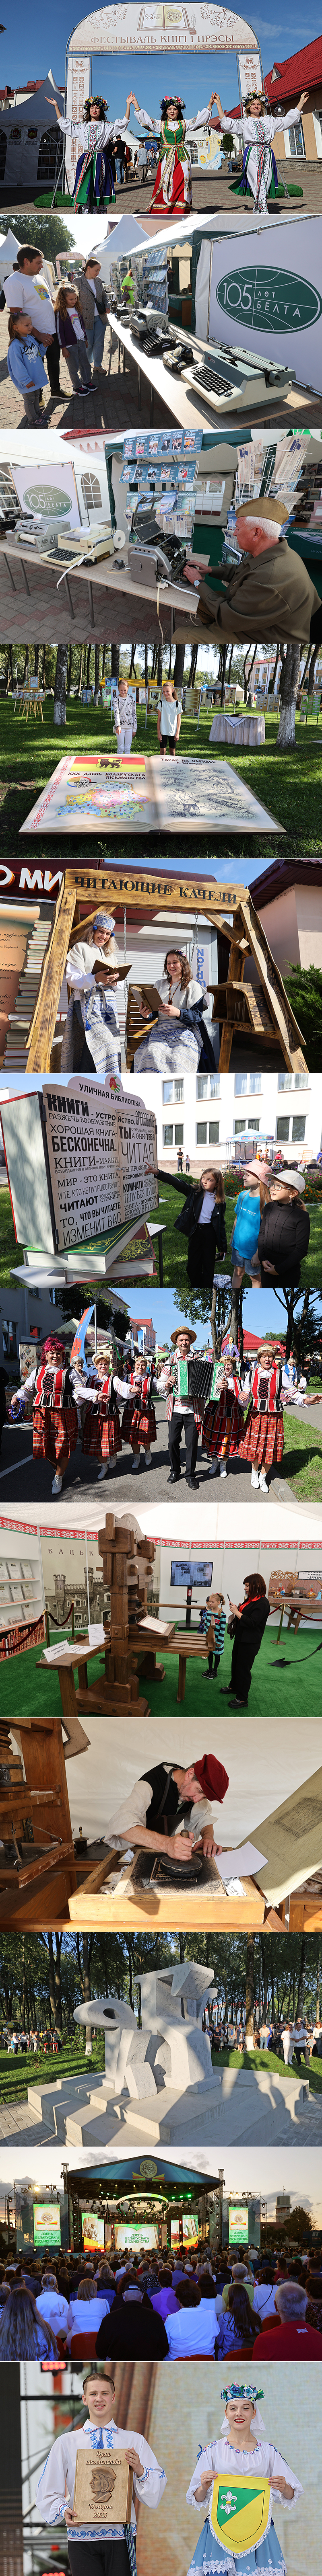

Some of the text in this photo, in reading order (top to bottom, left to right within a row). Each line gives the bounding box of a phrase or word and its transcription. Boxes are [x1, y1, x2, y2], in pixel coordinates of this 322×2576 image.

[90, 36, 157, 44] ФЕСТЫВАЛЬ
[197, 35, 234, 43] ПРЭСЫ
[223, 283, 252, 310] 105
[257, 301, 301, 318] БЕЛТА
[27, 494, 46, 509] 105
[74, 876, 237, 904] ЧИТАЮЩИЕ КАЧЕЛИ
[78, 1083, 141, 1107] УЛИЧНАЯ БИБЛИОТЕКА
[47, 1093, 89, 1117] КНИГИ
[95, 1112, 116, 1121] УСТРО
[48, 1113, 117, 1127] РАЗЖЕЧЬ ВООБРАЖЕНИЕ.
[118, 1110, 155, 1128] ЙСТВО, СПОСОБНОЕ
[50, 1124, 94, 1135] ХОРОШАЯ
[118, 1126, 132, 1139] ТЫ
[52, 1136, 117, 1152] БЕСКОНЕЧНА.
[121, 1142, 156, 1164] ЧИТАЯ,
[57, 1178, 77, 1188] МИР
[84, 1175, 97, 1183] ЭТО
[99, 1172, 120, 1181] КНИГА,
[123, 1180, 143, 1193] КОМНАТА
[72, 1188, 81, 1197] КТО
[123, 1191, 136, 1203] ТЕЛУ
[60, 1196, 98, 1213] ЧИТАЮТ
[124, 1202, 138, 1211] КНИГА
[125, 1207, 140, 1217] КОТОРУЮ
[141, 1205, 144, 1213] В
[60, 1202, 122, 1228] ТО, ЧТО ВЫ ЧИТАЕТЕ,
[63, 1212, 123, 1246] ИЗМЕНИТ ВАС.
[48, 1548, 100, 1556] БАЦЬК
[95, 2451, 111, 2459] Дзень
